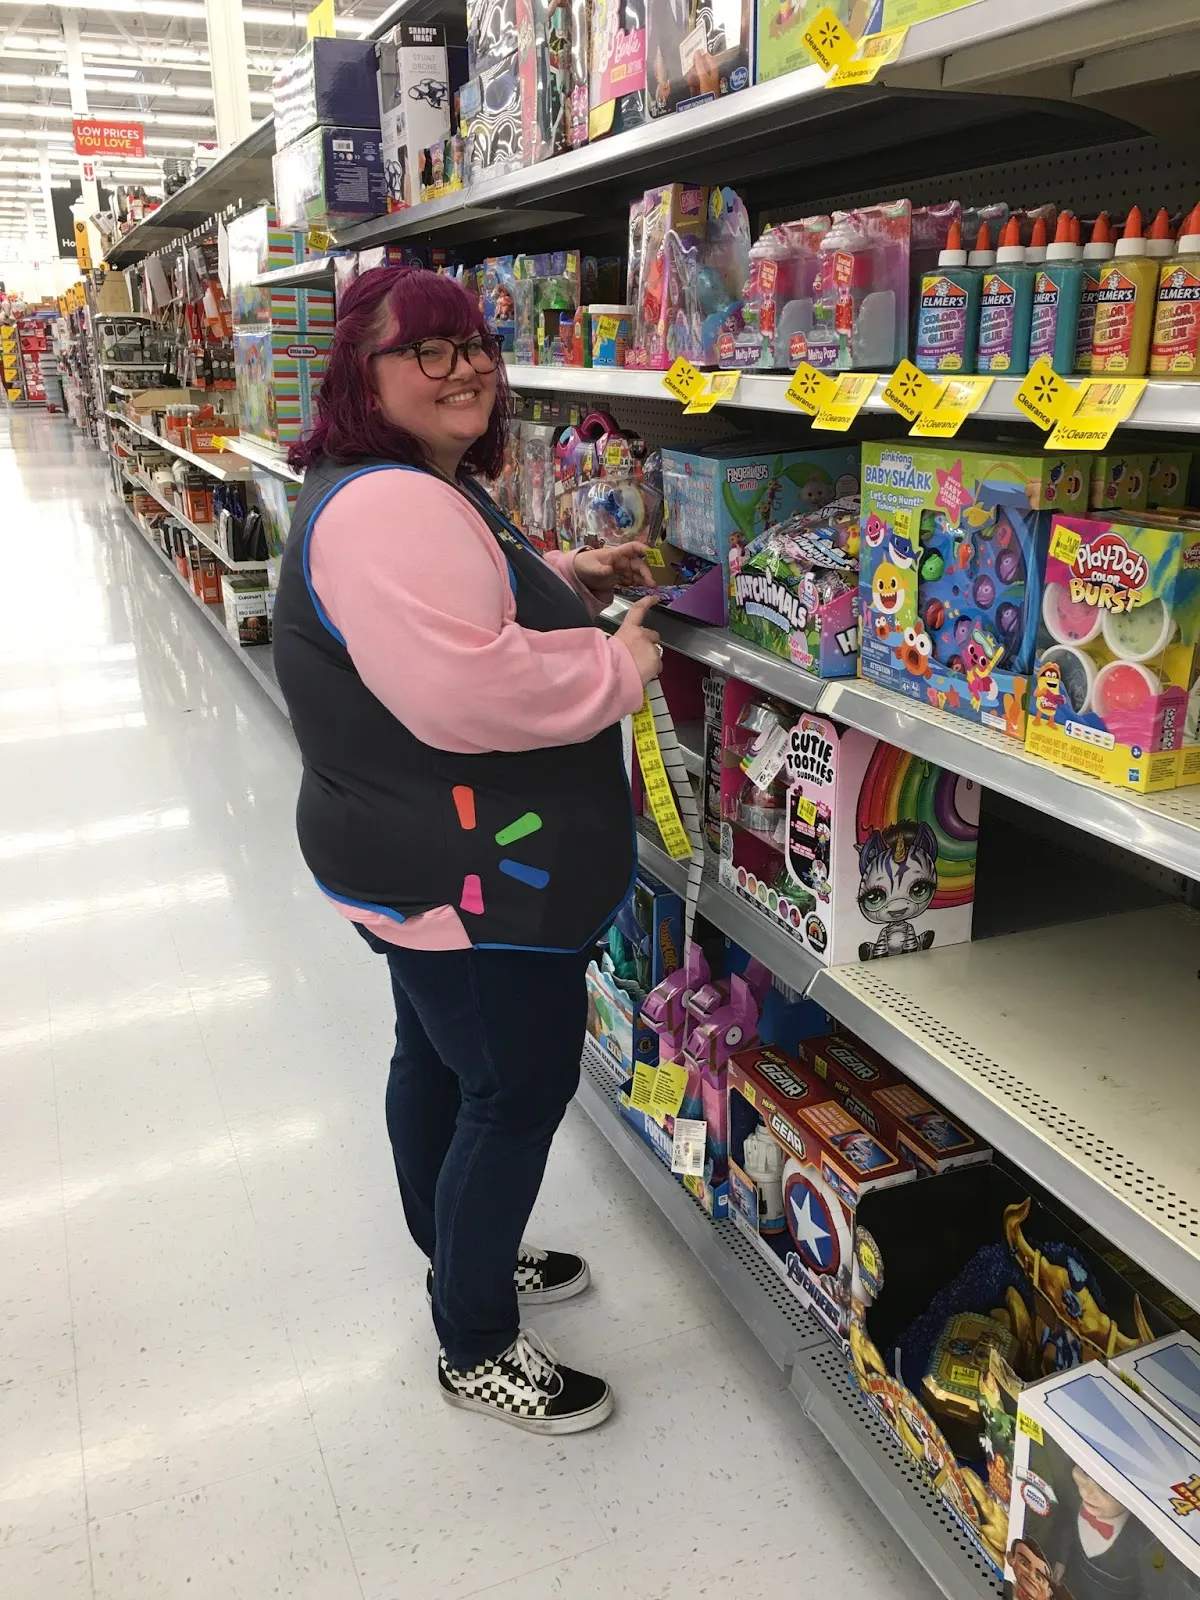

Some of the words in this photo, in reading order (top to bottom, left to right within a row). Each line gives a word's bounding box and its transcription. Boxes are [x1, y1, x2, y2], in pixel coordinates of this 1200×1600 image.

[408, 26, 437, 36] SHARPER
[412, 34, 434, 43] IMAGE
[412, 53, 437, 62] STUNT
[804, 32, 831, 68] Clearance
[412, 61, 438, 71] DRONE
[77, 126, 101, 137] LOW
[103, 128, 139, 140] PRICES
[77, 136, 101, 147] YOU
[1099, 289, 1133, 301] ELMER'S
[1160, 287, 1200, 300] ELMER'S
[922, 296, 965, 307] ELMER'S
[923, 310, 957, 326] COLOR
[928, 330, 955, 345] GLUE
[747, 347, 760, 360] Pops
[823, 347, 837, 361] Pops
[664, 377, 689, 400] Clearance
[787, 387, 816, 411] Clearance
[884, 388, 915, 417] Clearance
[1017, 393, 1052, 425] Clearance
[825, 413, 851, 424] Clearance
[925, 419, 959, 430] Clearance
[1066, 429, 1108, 441] Clearance
[881, 450, 913, 469] pinkfong
[865, 466, 890, 485] BABY
[892, 468, 932, 490] SHARK
[870, 491, 887, 502] Let's
[887, 493, 897, 503] Go
[1075, 544, 1145, 584] Play-Doh
[1091, 571, 1121, 586] COLOR
[1069, 578, 1143, 614] BURST
[1065, 722, 1073, 735] 4
[791, 731, 833, 763] CUTIE
[787, 754, 834, 784] TOOTIES
[796, 770, 823, 787] SURPRISE
[831, 1048, 874, 1080] GEAR
[759, 1062, 803, 1097] GEAR
[761, 1097, 778, 1113] NERF
[771, 1114, 804, 1156] GEAR
